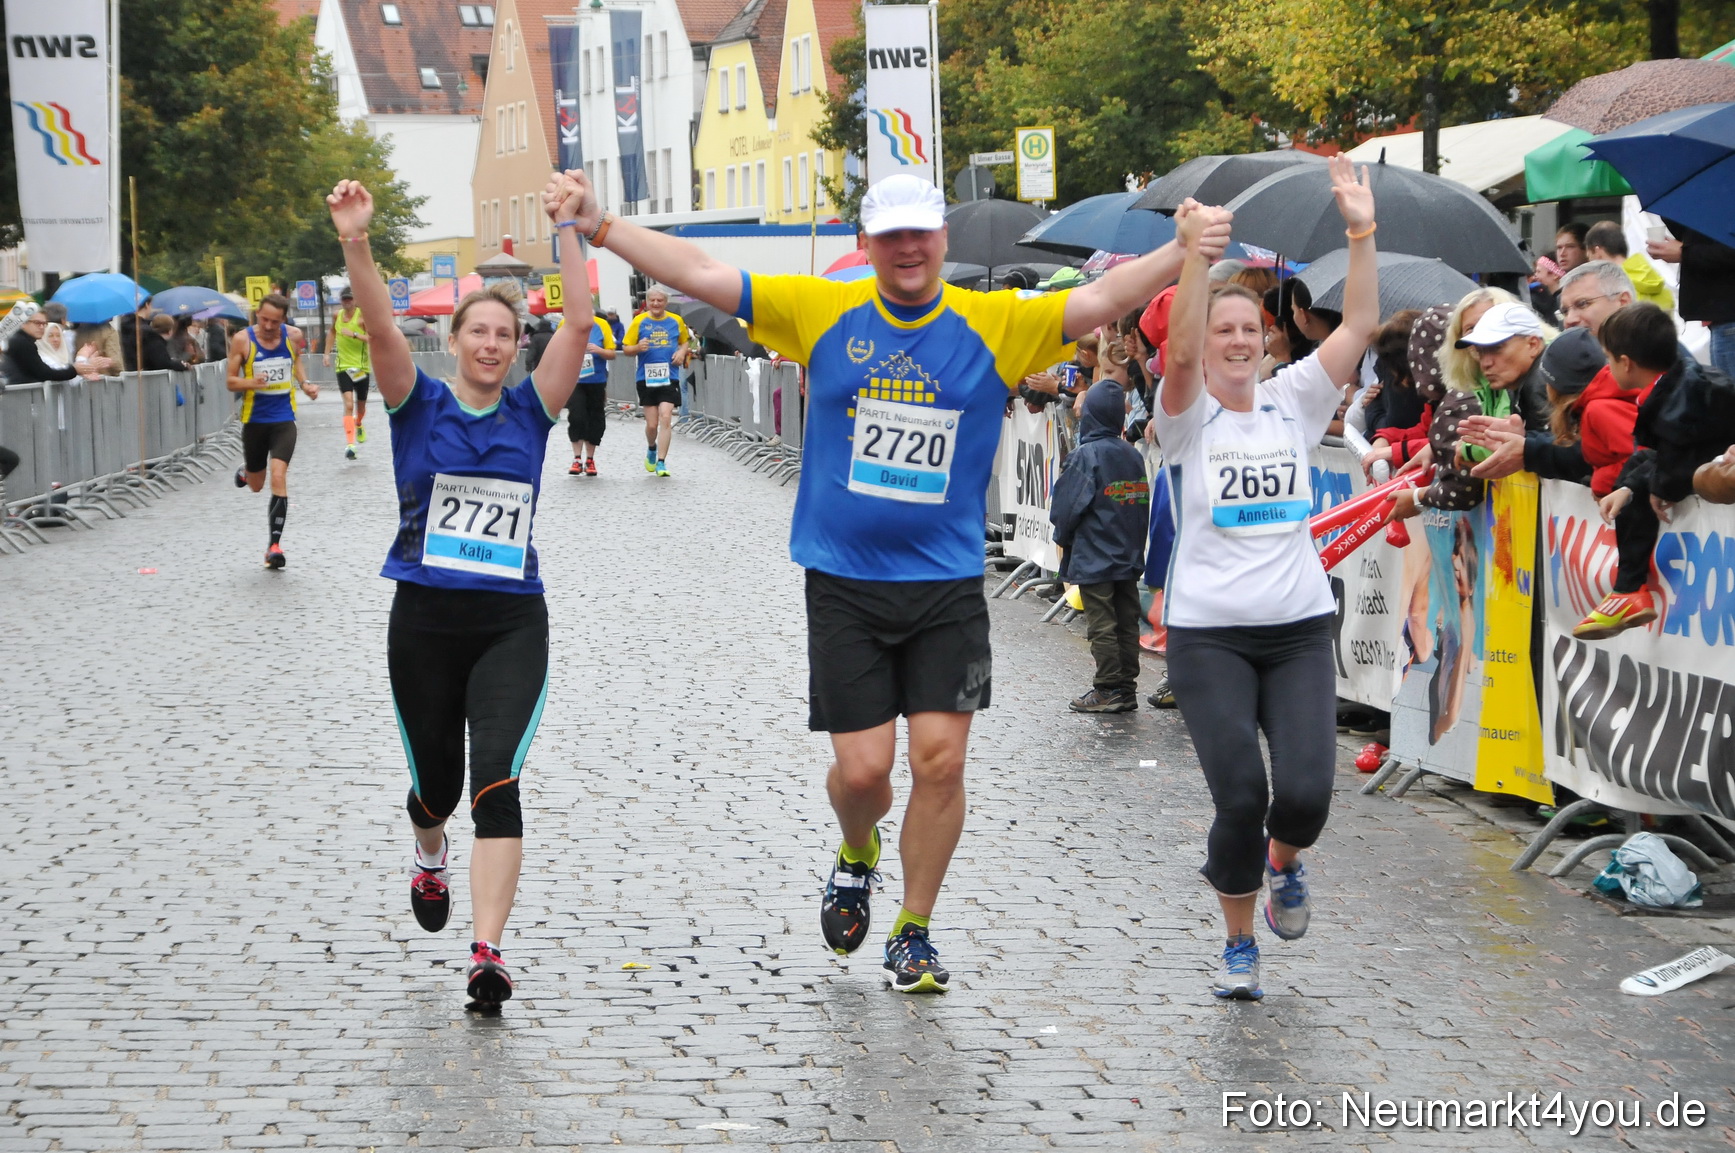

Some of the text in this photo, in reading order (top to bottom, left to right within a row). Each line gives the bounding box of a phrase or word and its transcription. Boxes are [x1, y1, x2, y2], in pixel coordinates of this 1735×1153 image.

[729, 136, 748, 157] HOTEL
[253, 287, 264, 302] D
[550, 285, 561, 300] D
[648, 368, 668, 378] 2547
[859, 406, 942, 428] PARTL Neumarkt
[862, 424, 946, 467] 2720
[1209, 449, 1289, 463] PARTL Neumarkt
[880, 470, 918, 488] David
[1219, 462, 1297, 500] 2657
[436, 482, 519, 502] PARTL Neumarkt
[438, 496, 520, 541] 2721
[1238, 507, 1287, 523] Annette
[1333, 511, 1382, 556] Audi BKK
[459, 542, 493, 562] Katja
[1351, 640, 1383, 667] 92318
